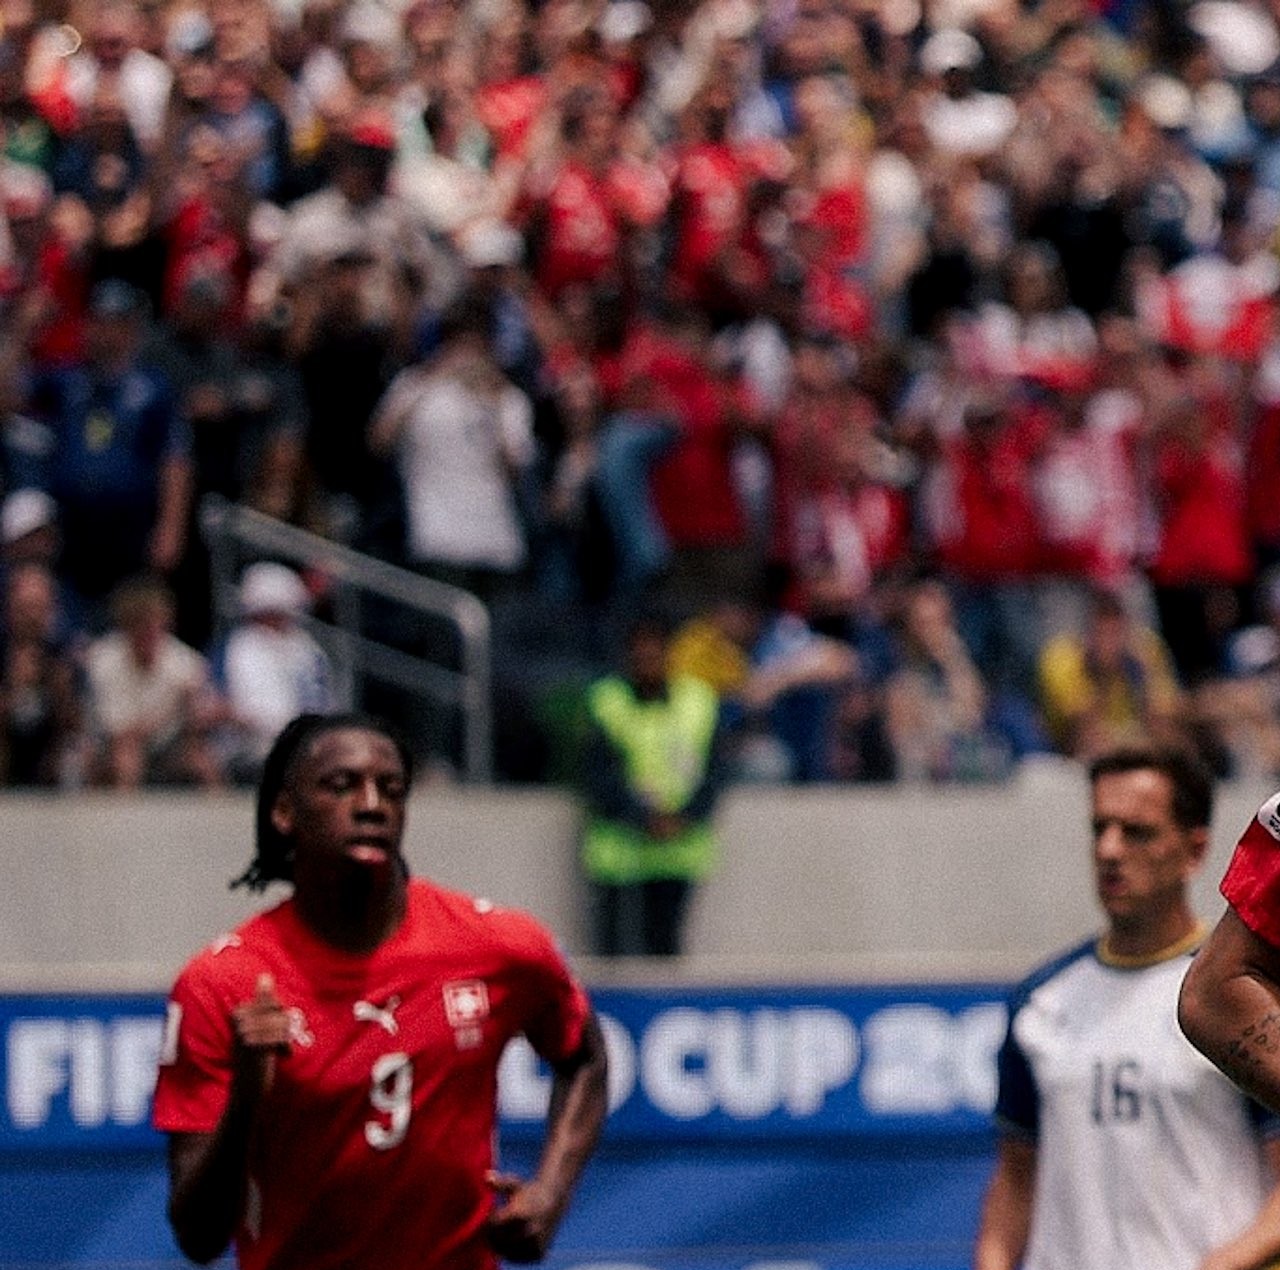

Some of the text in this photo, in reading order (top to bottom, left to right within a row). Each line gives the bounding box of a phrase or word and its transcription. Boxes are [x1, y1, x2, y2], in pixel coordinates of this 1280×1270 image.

[6, 1014, 167, 1130] FIF
[641, 1006, 861, 1119] CUP
[364, 1052, 414, 1150] 9
[1090, 1056, 1143, 1126] 16
